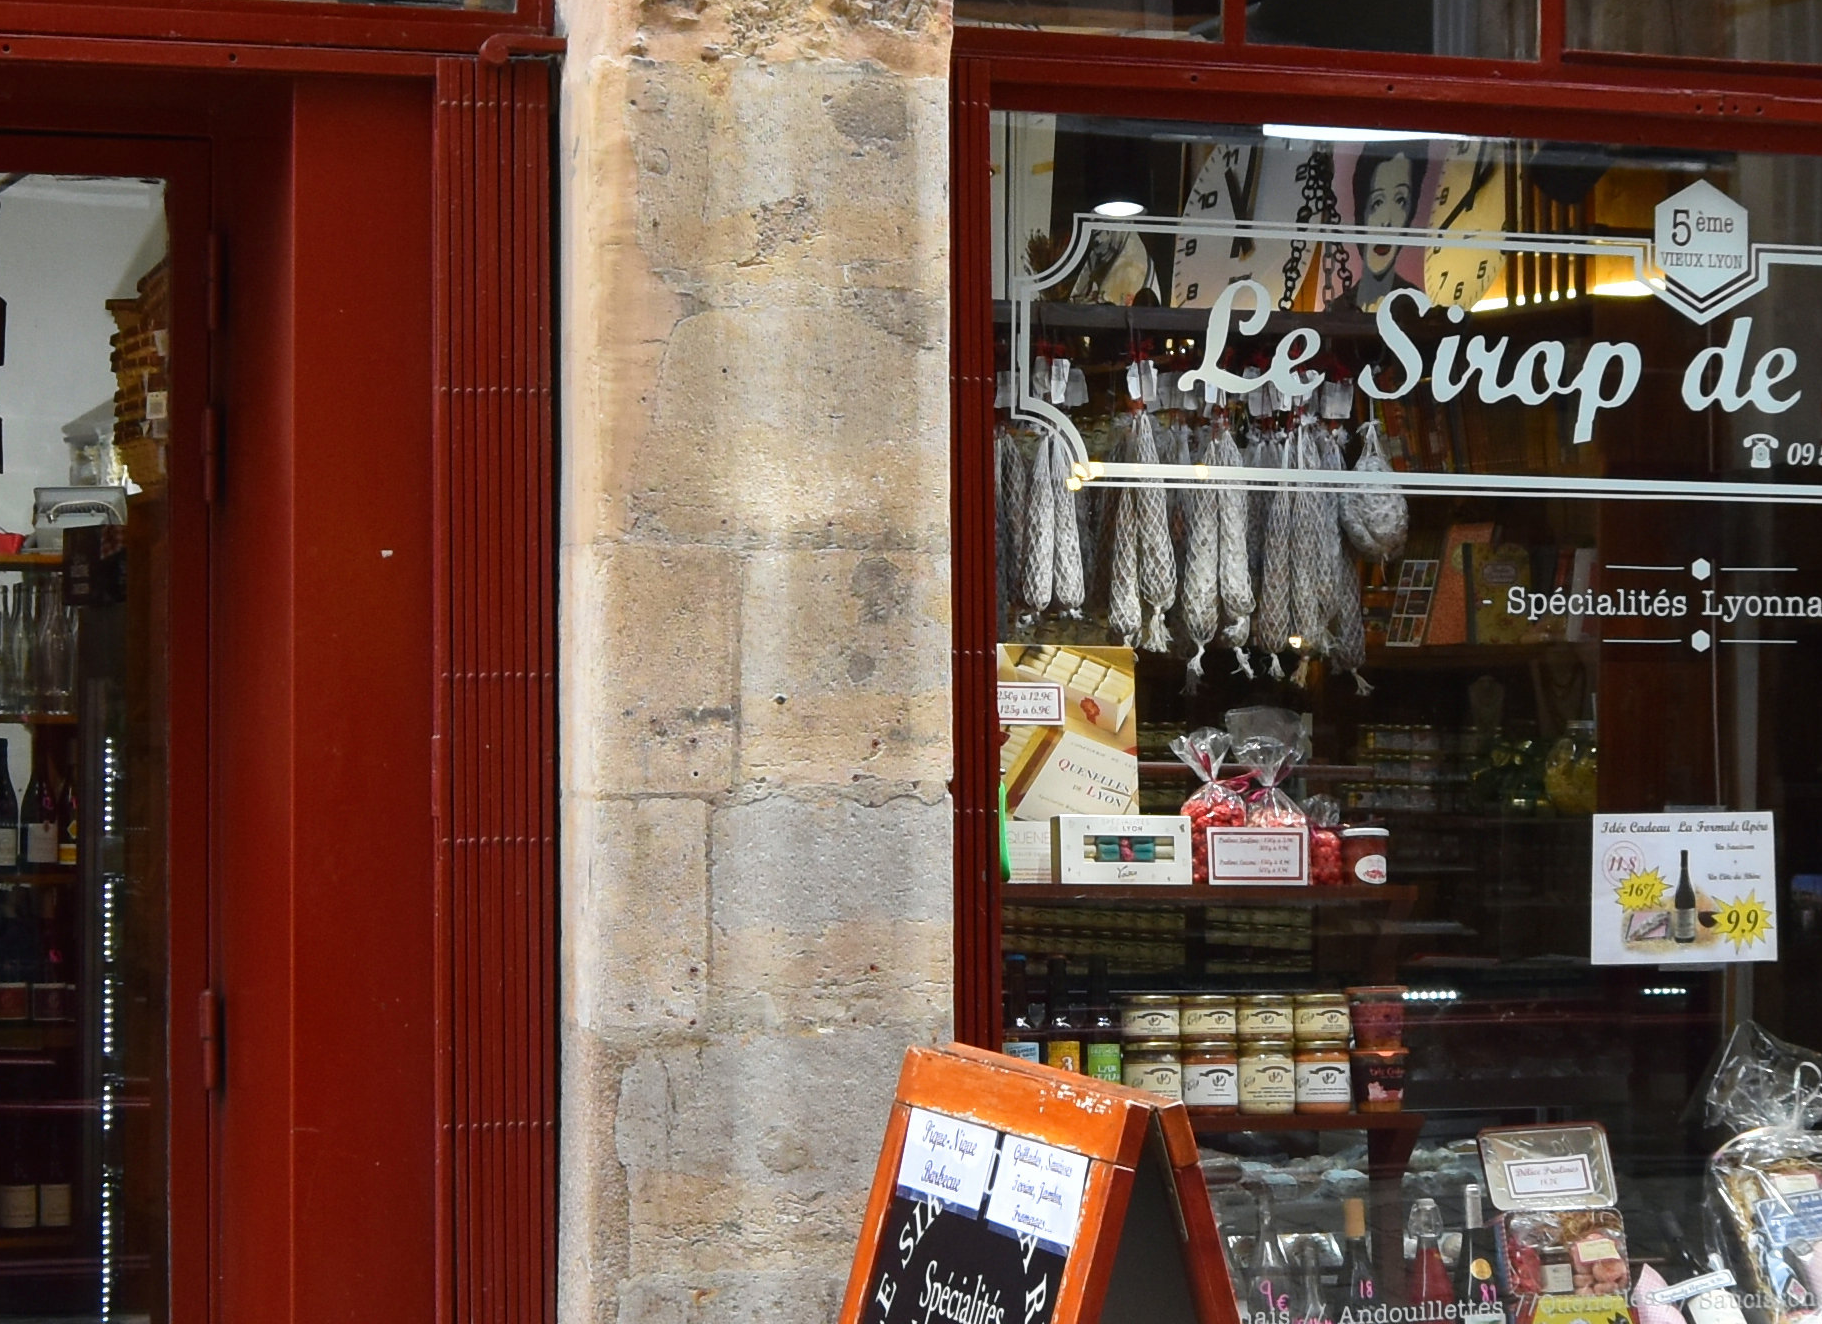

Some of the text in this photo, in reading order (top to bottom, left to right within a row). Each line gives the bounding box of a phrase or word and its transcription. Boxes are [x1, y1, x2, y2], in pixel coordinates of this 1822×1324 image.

[1671, 208, 1734, 247] 5 ème
[1661, 252, 1743, 269] VIEUX LYON
[1177, 280, 1325, 398] Le
[1358, 288, 1642, 444] Sirop
[1681, 318, 1801, 415] de
[1787, 442, 1817, 466] 09
[1506, 586, 1687, 620] Spécialités
[1058, 757, 1130, 794] QUENELLES
[1086, 785, 1122, 808] LYON
[1601, 820, 1626, 834] Idée
[1630, 820, 1670, 834] Cadeau
[1678, 821, 1692, 833] La
[1726, 909, 1759, 935] 9.9
